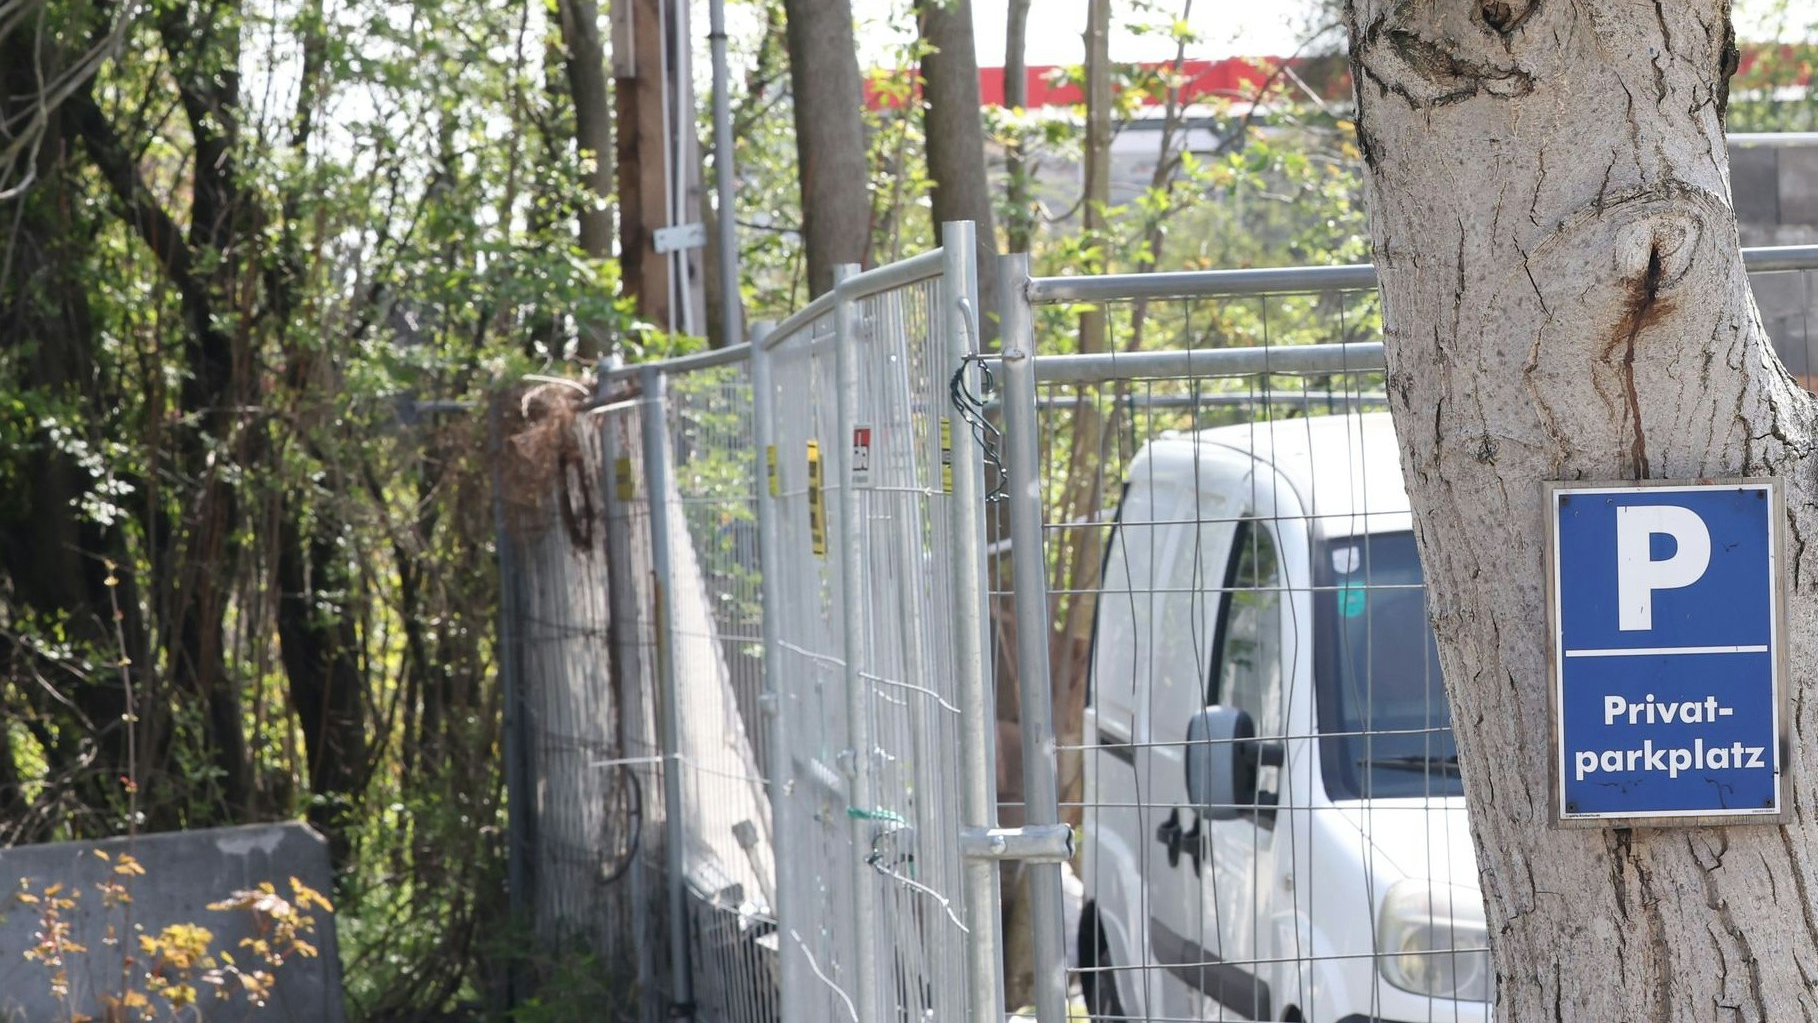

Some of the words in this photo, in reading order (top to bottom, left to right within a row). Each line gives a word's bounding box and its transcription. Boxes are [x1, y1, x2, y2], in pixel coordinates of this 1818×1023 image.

[1616, 505, 1712, 632] P
[1604, 694, 1734, 725] Privat-
[1575, 738, 1765, 781] parkplatz
